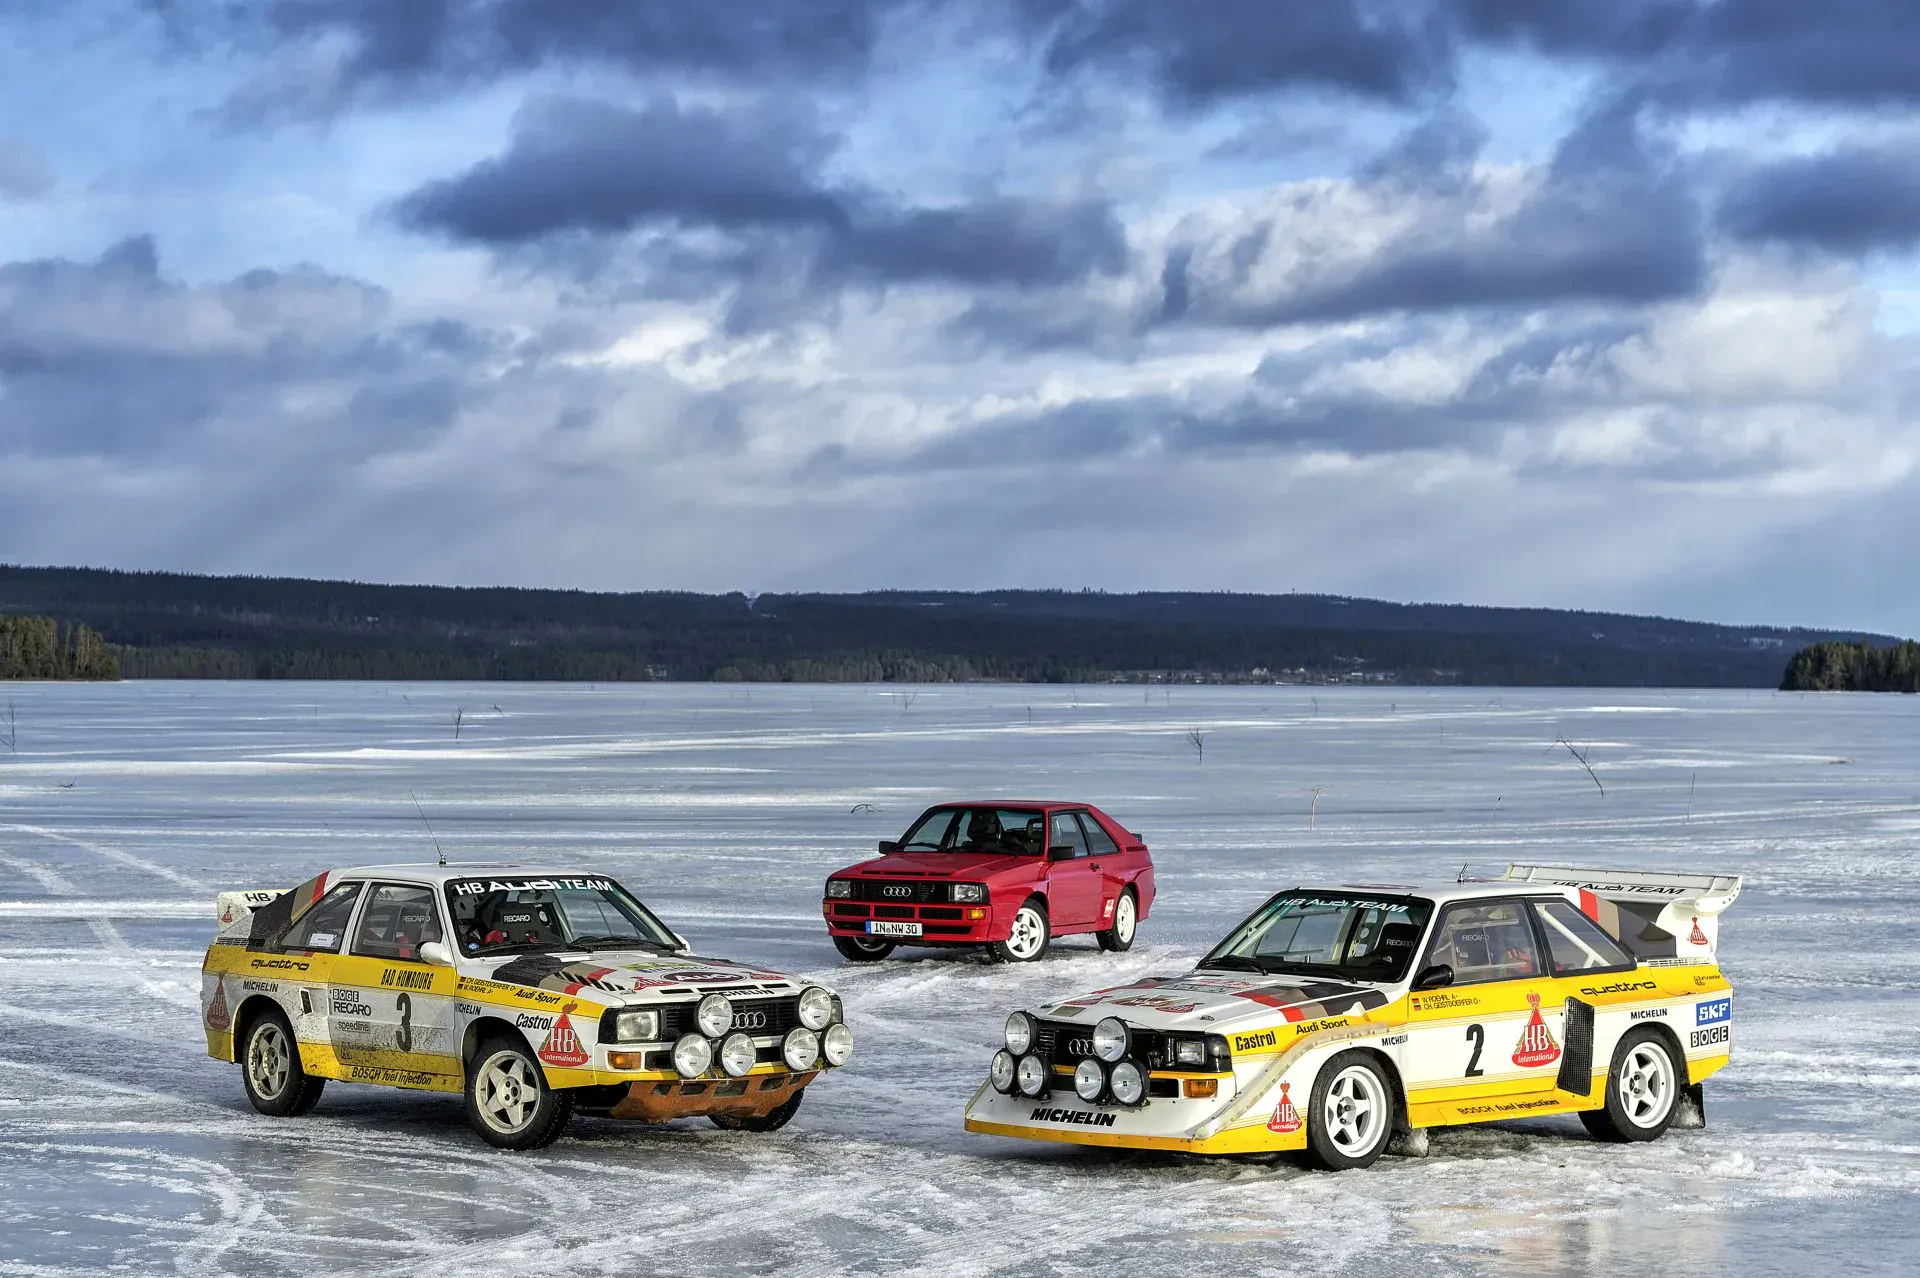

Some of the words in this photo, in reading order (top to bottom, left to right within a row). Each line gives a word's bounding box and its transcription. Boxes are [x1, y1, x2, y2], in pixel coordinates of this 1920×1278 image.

[455, 883, 485, 896] HB
[559, 879, 615, 892] TEAM
[1627, 885, 1686, 895] TEAM
[244, 893, 272, 902] HB
[1278, 898, 1307, 907] HB
[1351, 900, 1409, 913] TEAM
[503, 914, 531, 923] RECARO
[874, 922, 886, 933] IN
[891, 923, 904, 934] NW
[905, 924, 918, 935] 30
[251, 958, 310, 971] quattro
[242, 980, 279, 993] MICHELIN
[381, 968, 397, 986] BAD
[396, 970, 434, 990] HOMBOURG
[333, 989, 359, 1003] BOGE
[514, 988, 536, 999] Audi
[534, 992, 561, 1005] Sport
[1580, 981, 1657, 996] quattro
[333, 1001, 372, 1016] RECARO
[1630, 1008, 1668, 1020] MICHELIN
[1699, 1002, 1729, 1022] SKF
[396, 992, 412, 1053] 3
[516, 1013, 553, 1031] Castrol
[1296, 1022, 1320, 1035] Audi
[1320, 1018, 1349, 1030] Sport
[549, 1027, 576, 1053] HB
[1235, 1030, 1277, 1052] Castrol
[1524, 1024, 1550, 1053] HB
[1690, 1025, 1729, 1048] BOGE
[544, 1053, 583, 1063] international
[1465, 1023, 1485, 1078] 2
[1517, 1052, 1555, 1063] international
[351, 1067, 382, 1081] BOSCH
[382, 1070, 398, 1083] fuel
[398, 1071, 433, 1086] injection
[1277, 1103, 1294, 1123] HB
[1457, 1104, 1495, 1115] BOSCH
[1495, 1103, 1517, 1111] fuel
[1516, 1098, 1560, 1110] injection
[1029, 1108, 1117, 1127] MICHELIN
